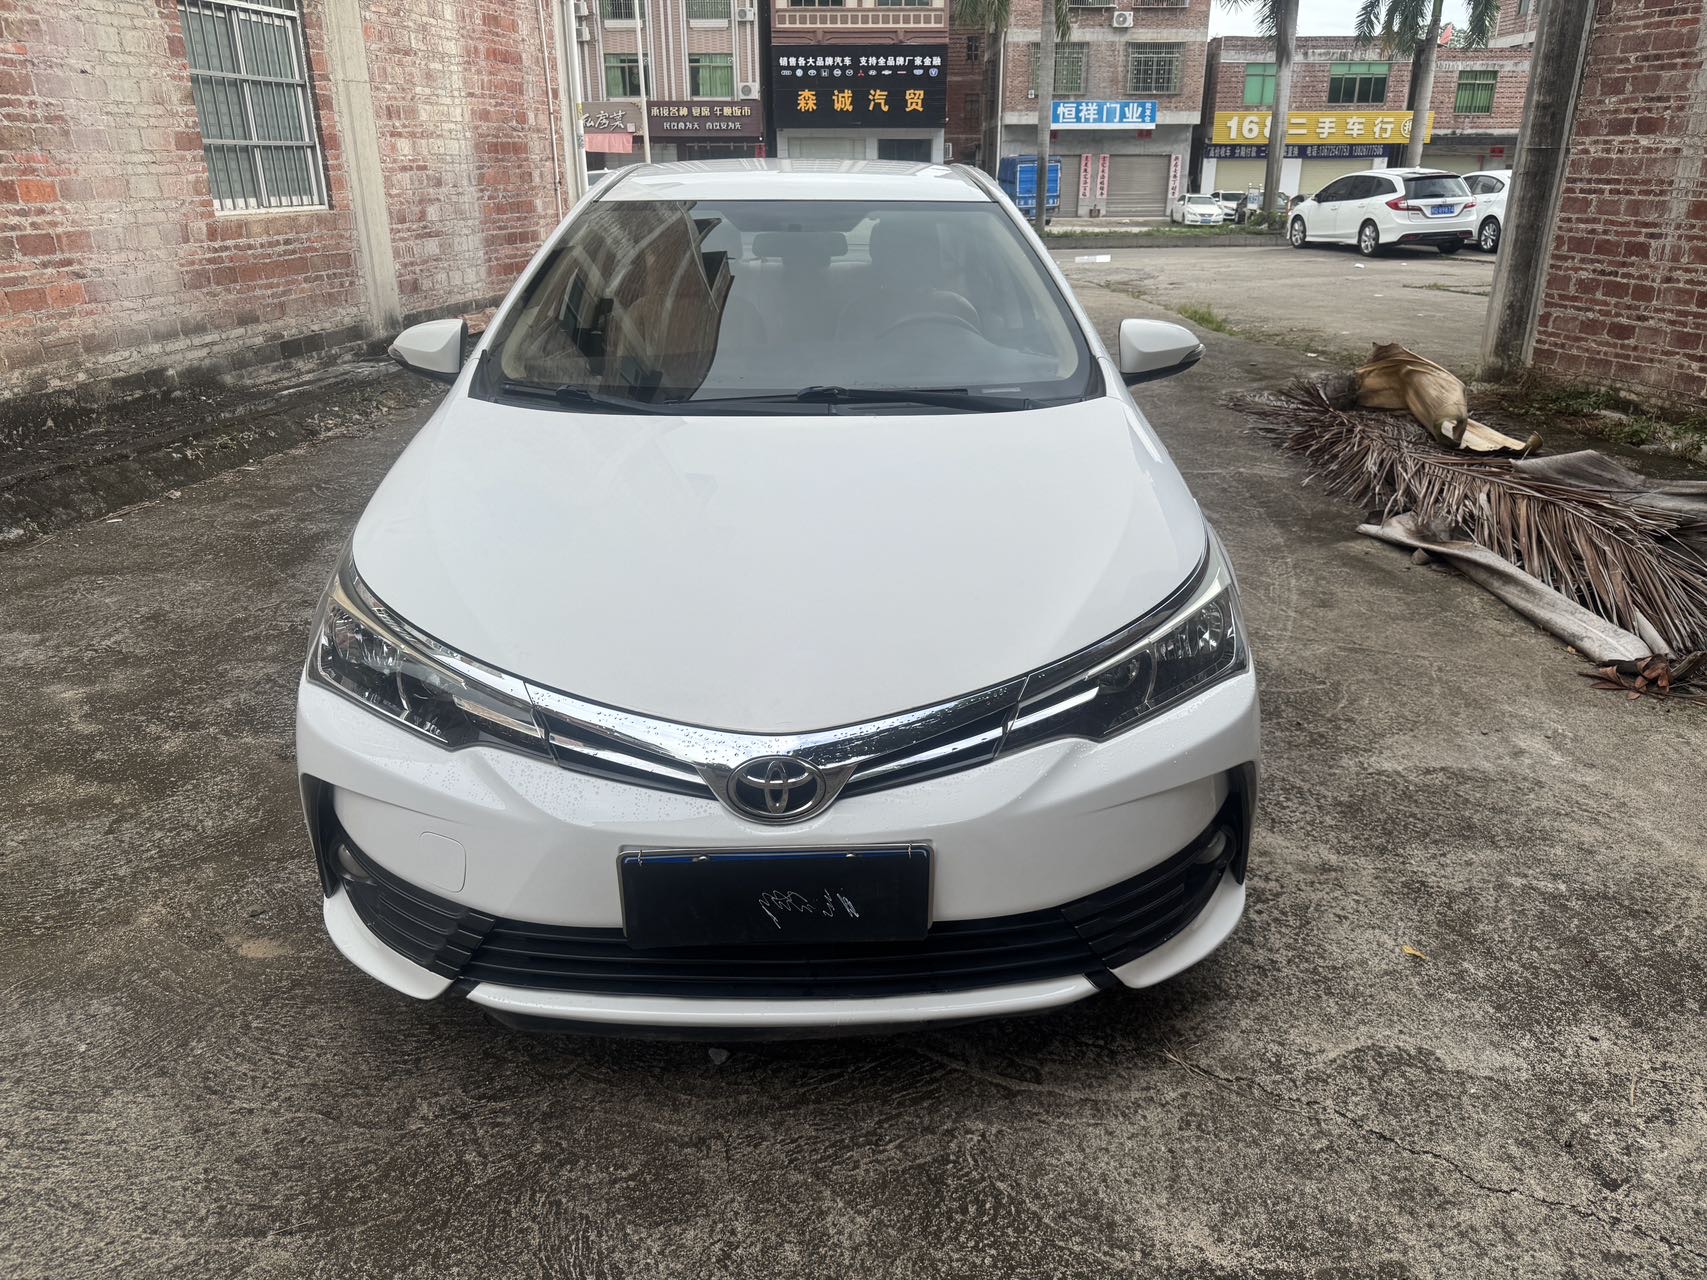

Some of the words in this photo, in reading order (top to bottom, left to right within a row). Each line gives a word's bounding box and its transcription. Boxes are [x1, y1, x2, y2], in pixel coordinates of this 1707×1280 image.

[779, 56, 852, 66] 销售各大品牌汽车
[859, 56, 942, 66] 支持全品牌厂家金融
[797, 89, 925, 112] 森诚汽贸
[650, 106, 688, 117] 承接各种
[692, 106, 711, 117] 宴席
[714, 106, 751, 117] 午晚饭市
[1057, 102, 1142, 123] 恒祥门业
